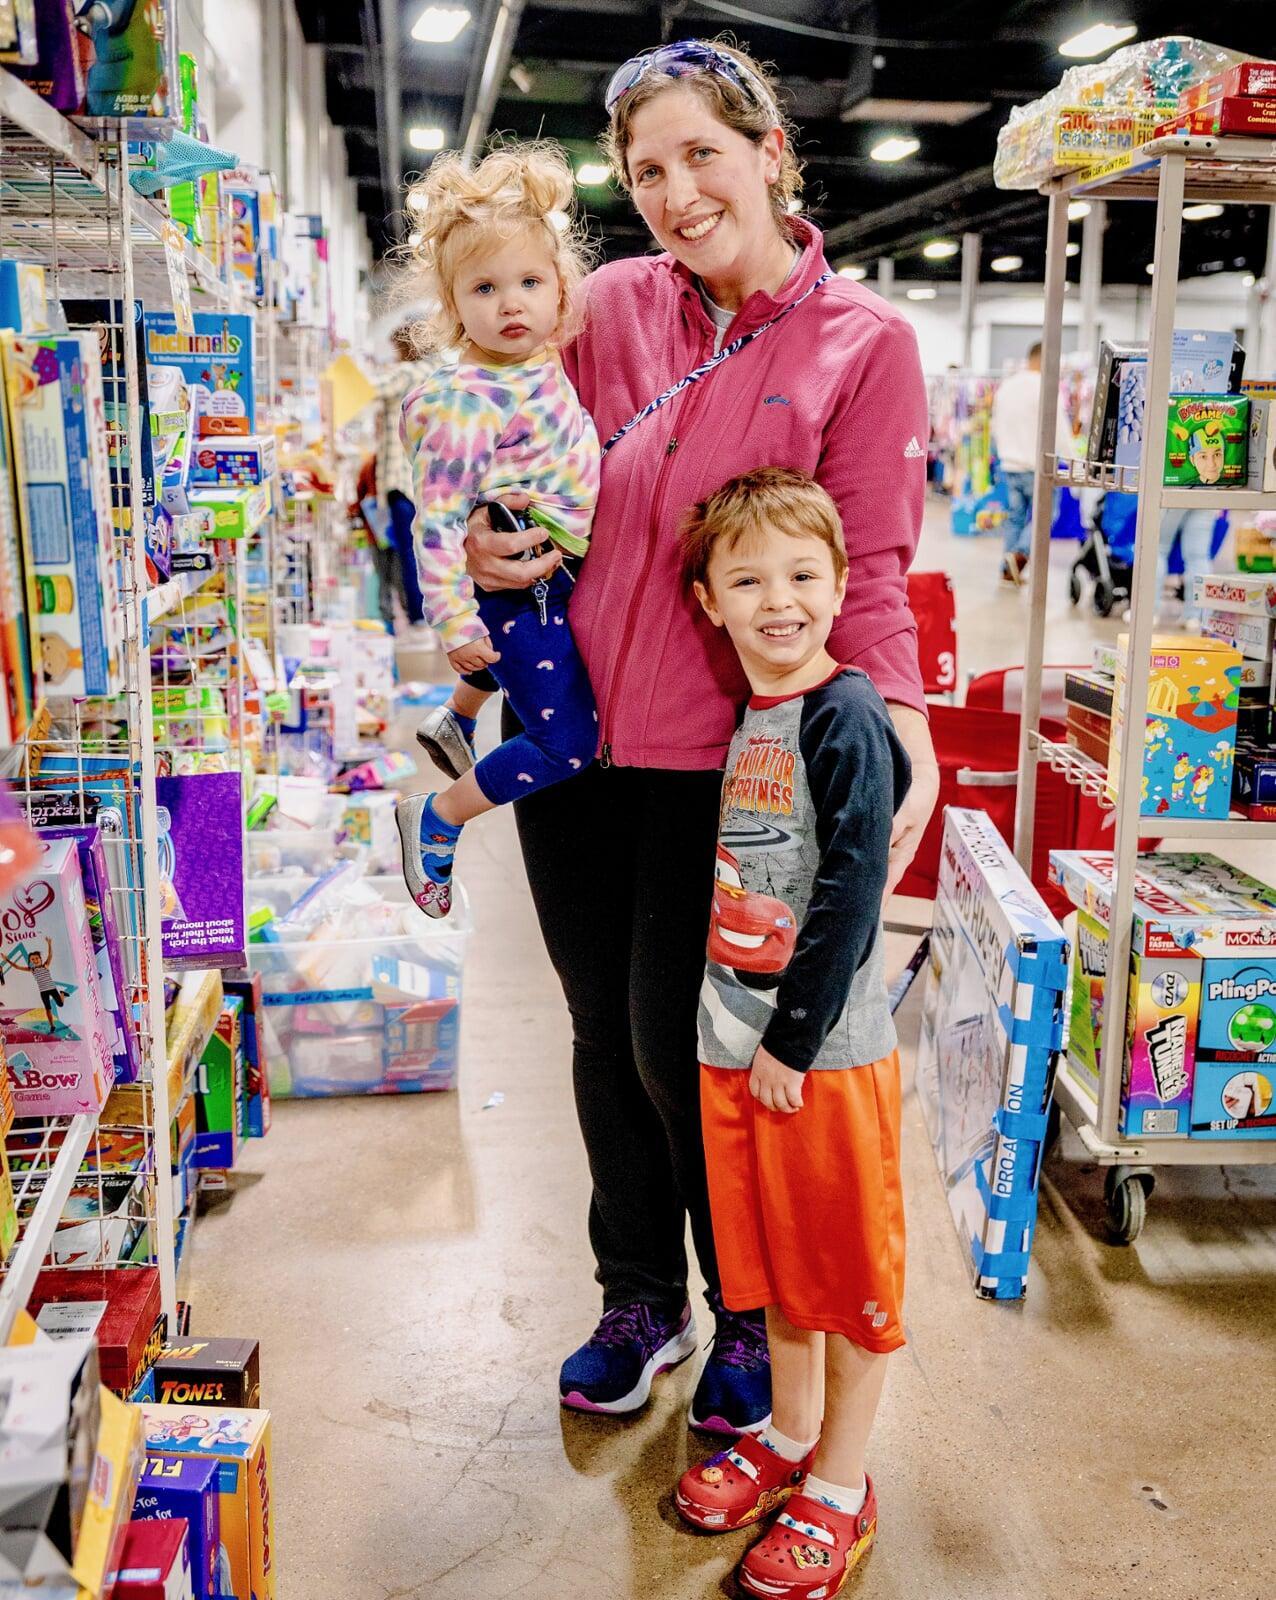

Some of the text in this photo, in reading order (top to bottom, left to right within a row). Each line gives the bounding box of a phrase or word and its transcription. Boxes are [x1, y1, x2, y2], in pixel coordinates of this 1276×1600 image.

[936, 652, 955, 685] 3
[171, 918, 235, 931] about money
[5, 928, 37, 945] Siwa
[180, 929, 205, 938] their
[206, 927, 234, 937] teach
[170, 935, 235, 948] What the rich
[1148, 941, 1175, 949] FASTER
[1164, 973, 1175, 1007] DVD
[1209, 1119, 1225, 1131] SET
[1226, 1119, 1239, 1130] UP
